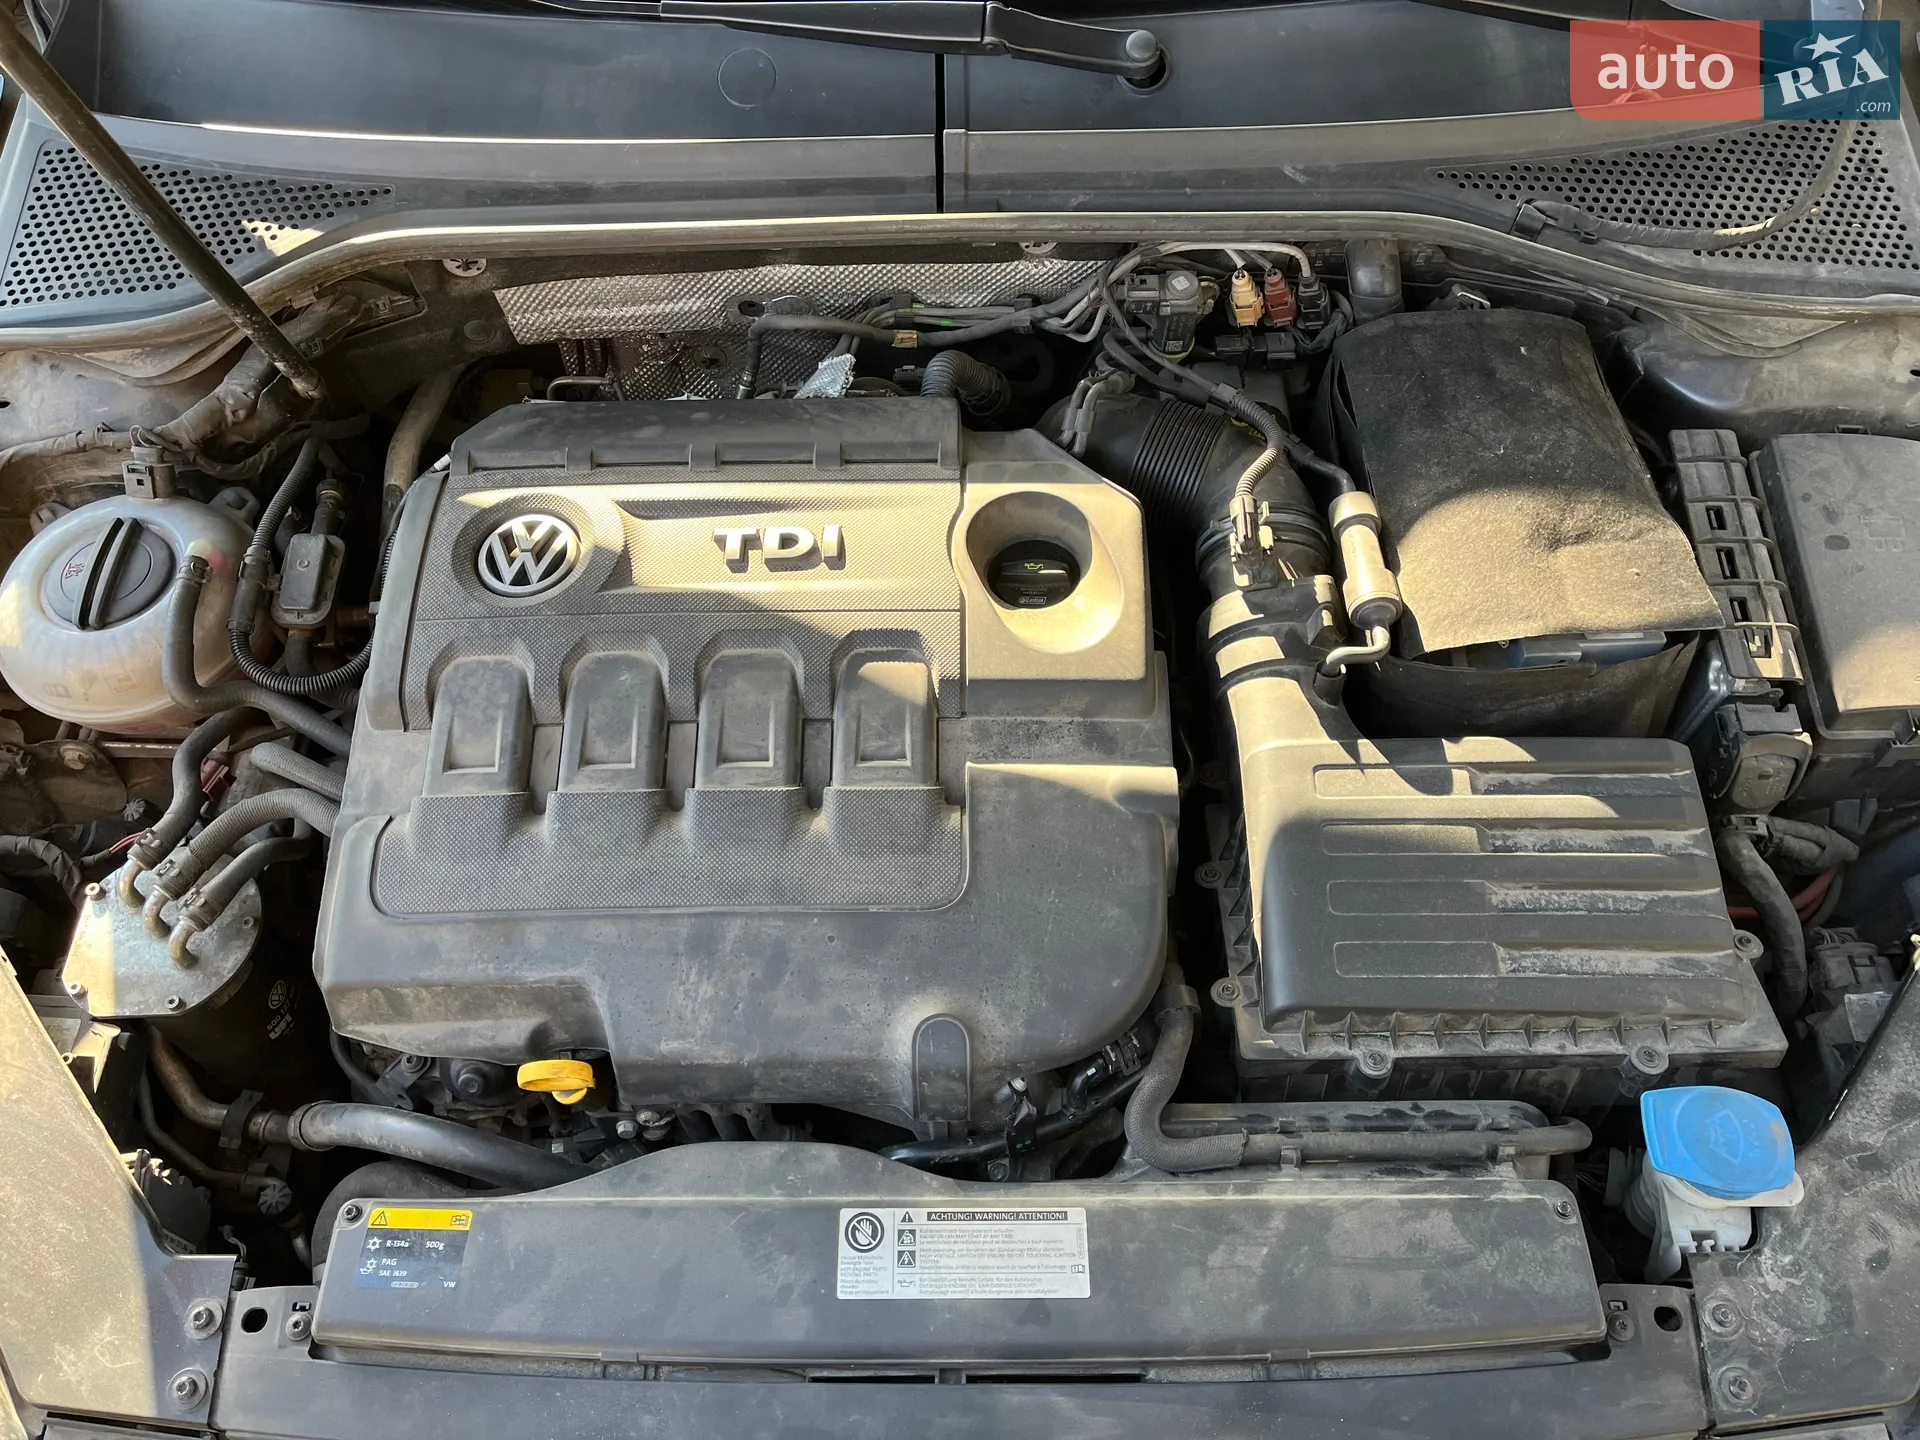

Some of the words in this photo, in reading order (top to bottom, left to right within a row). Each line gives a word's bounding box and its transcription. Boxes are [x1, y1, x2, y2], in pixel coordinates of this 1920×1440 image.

[714, 525, 845, 573] TDI
[386, 1240, 409, 1248] R-134a
[425, 1241, 444, 1250] 500g
